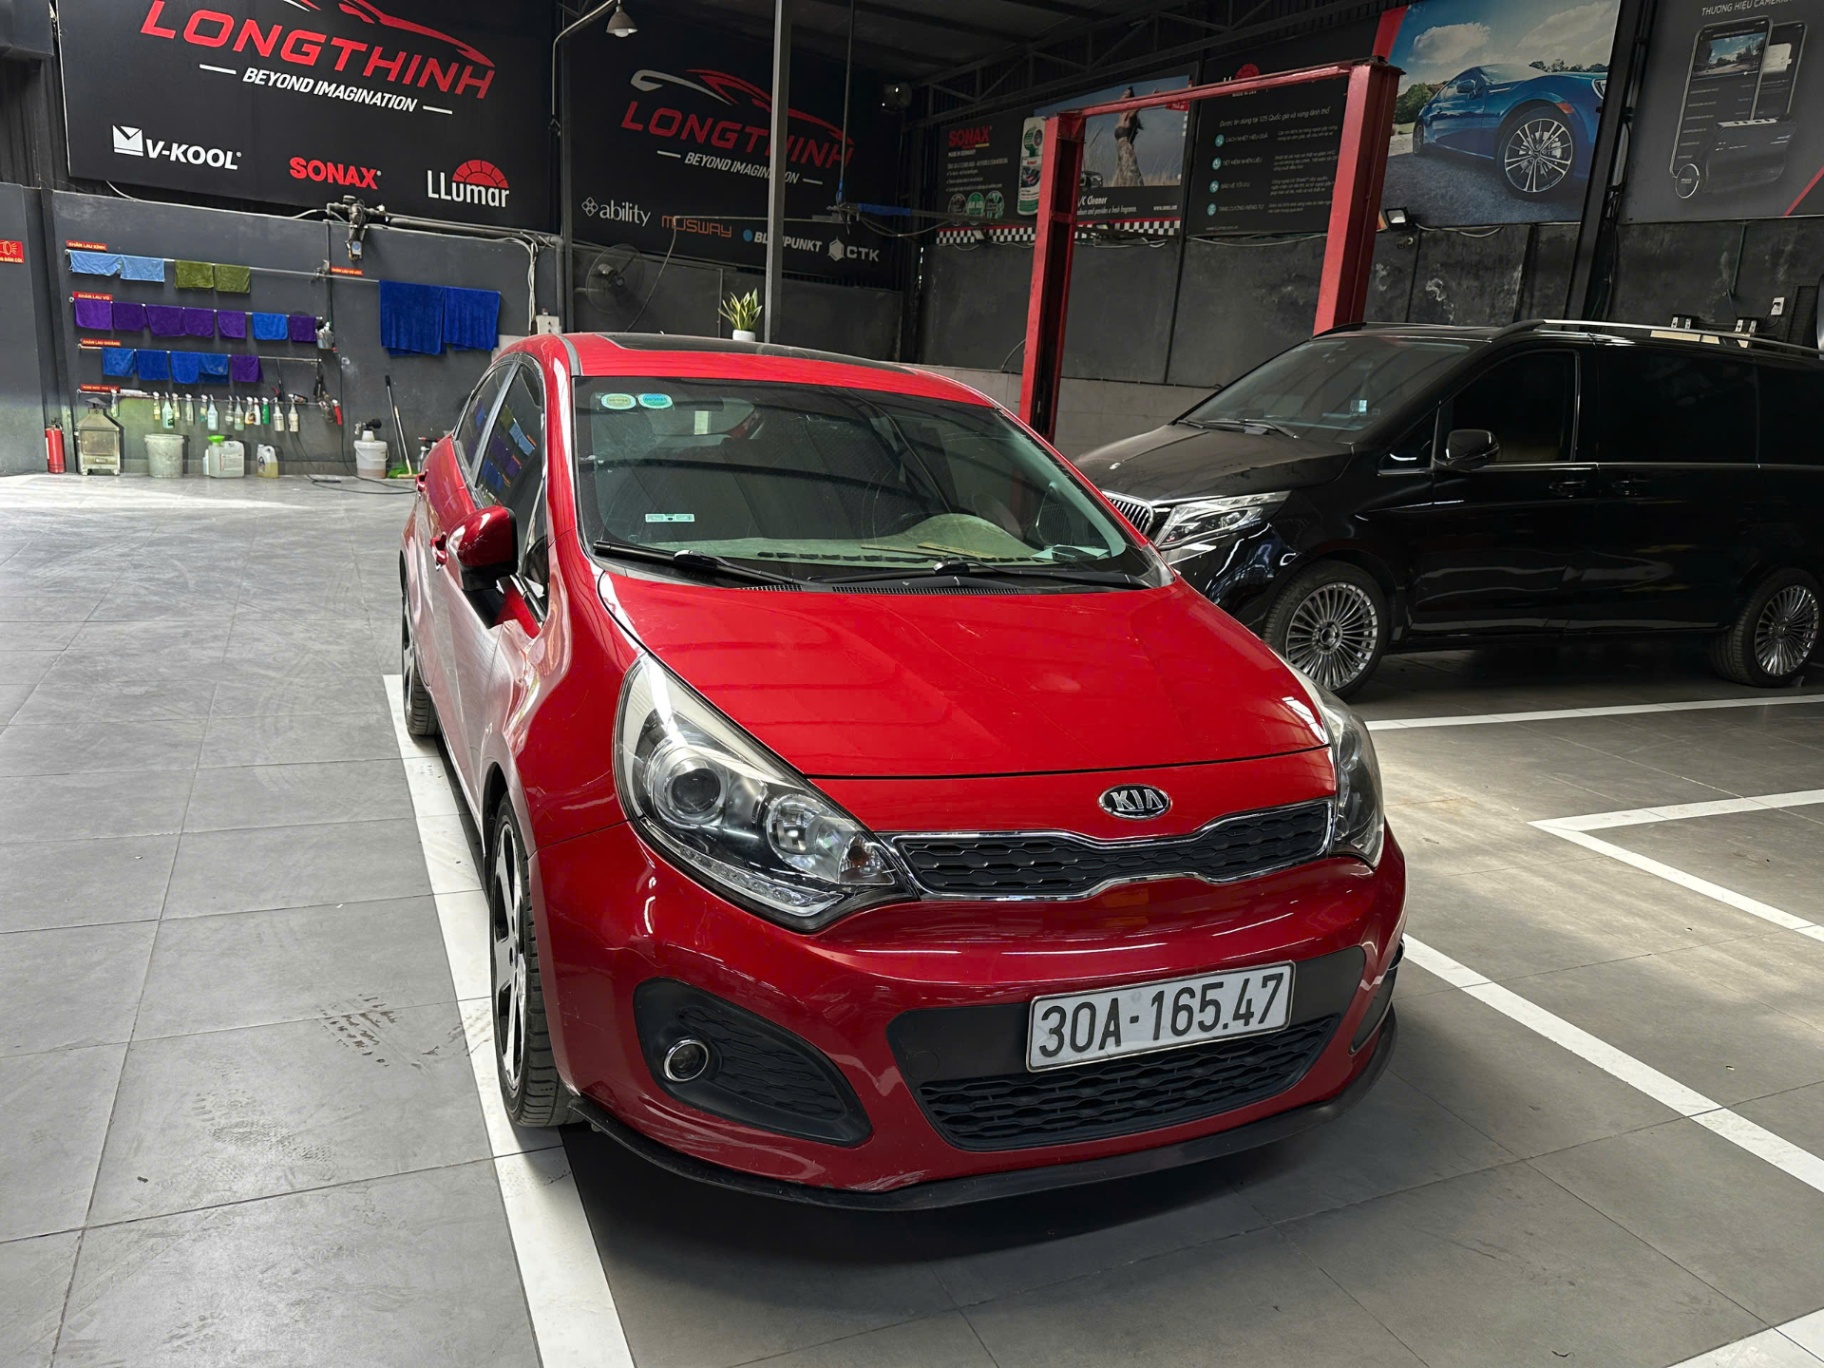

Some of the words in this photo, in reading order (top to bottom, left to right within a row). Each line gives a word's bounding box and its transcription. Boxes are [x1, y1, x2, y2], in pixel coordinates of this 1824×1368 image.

[140, 0, 495, 99] LONGTHINH
[242, 67, 314, 93] BEYOND
[313, 80, 418, 112] IMAGINATION
[948, 126, 990, 147] SONAX
[289, 156, 381, 191] SONAX
[684, 152, 731, 171] BEYOND
[730, 160, 800, 184] IMAGINON
[427, 169, 510, 208] LLumar
[599, 199, 651, 227] ability
[661, 215, 732, 238] MUSWAY
[754, 232, 823, 253] BLPUNKT
[847, 247, 880, 262] CTK
[1110, 789, 1163, 812] KIA
[1039, 973, 1284, 1057] 30A-165.47
